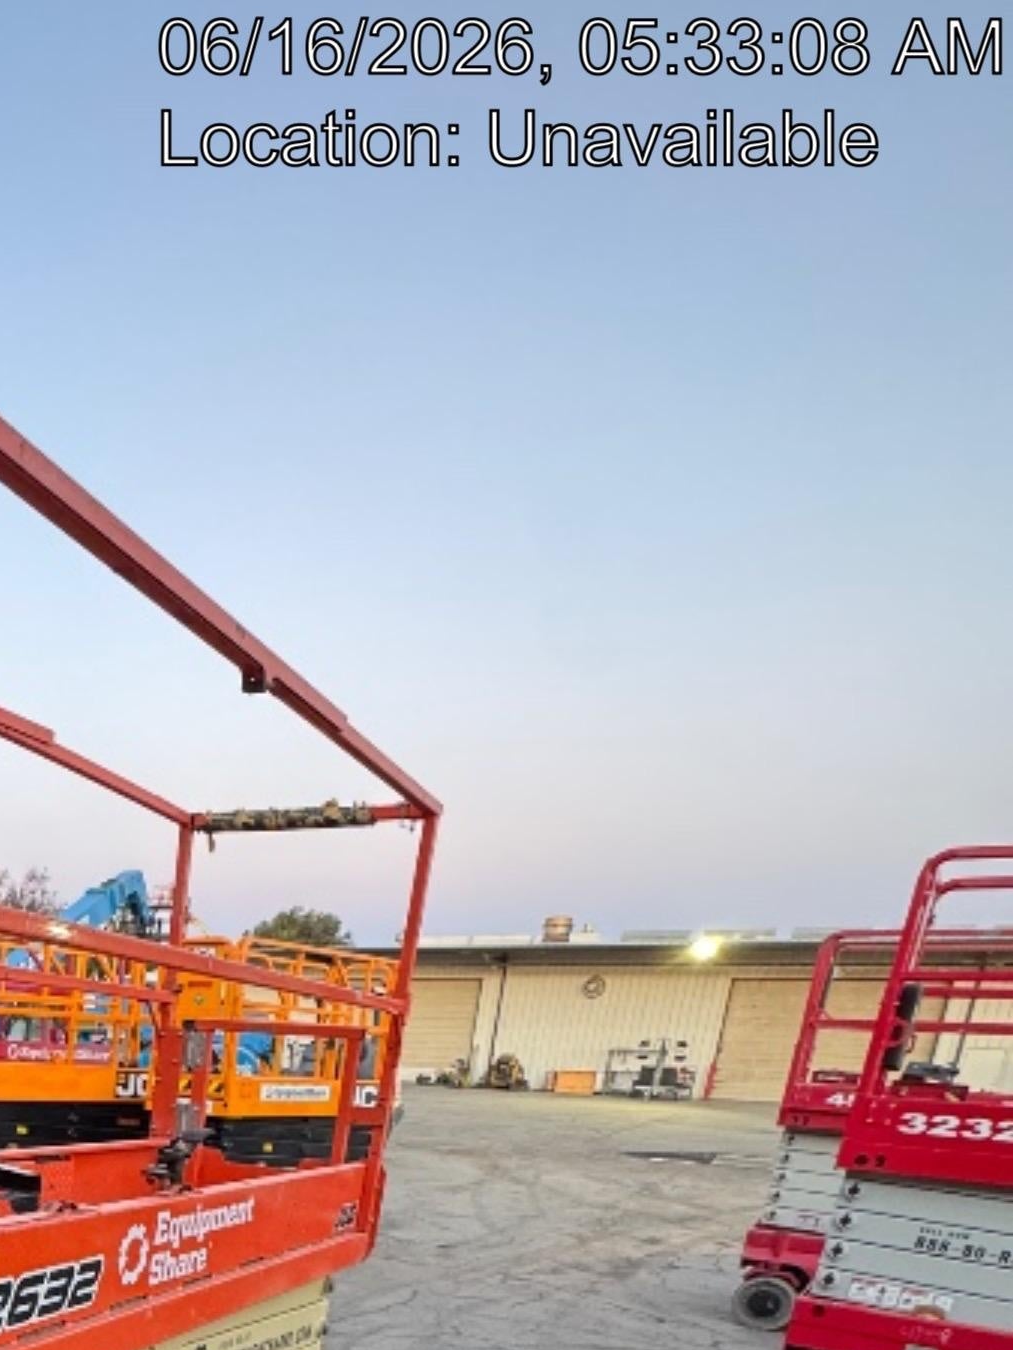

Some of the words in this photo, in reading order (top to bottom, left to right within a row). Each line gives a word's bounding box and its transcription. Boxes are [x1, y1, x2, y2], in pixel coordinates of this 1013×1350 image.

[116, 1072, 149, 1097] JC
[152, 1197, 255, 1248] Equipment
[148, 1247, 208, 1286] Share
